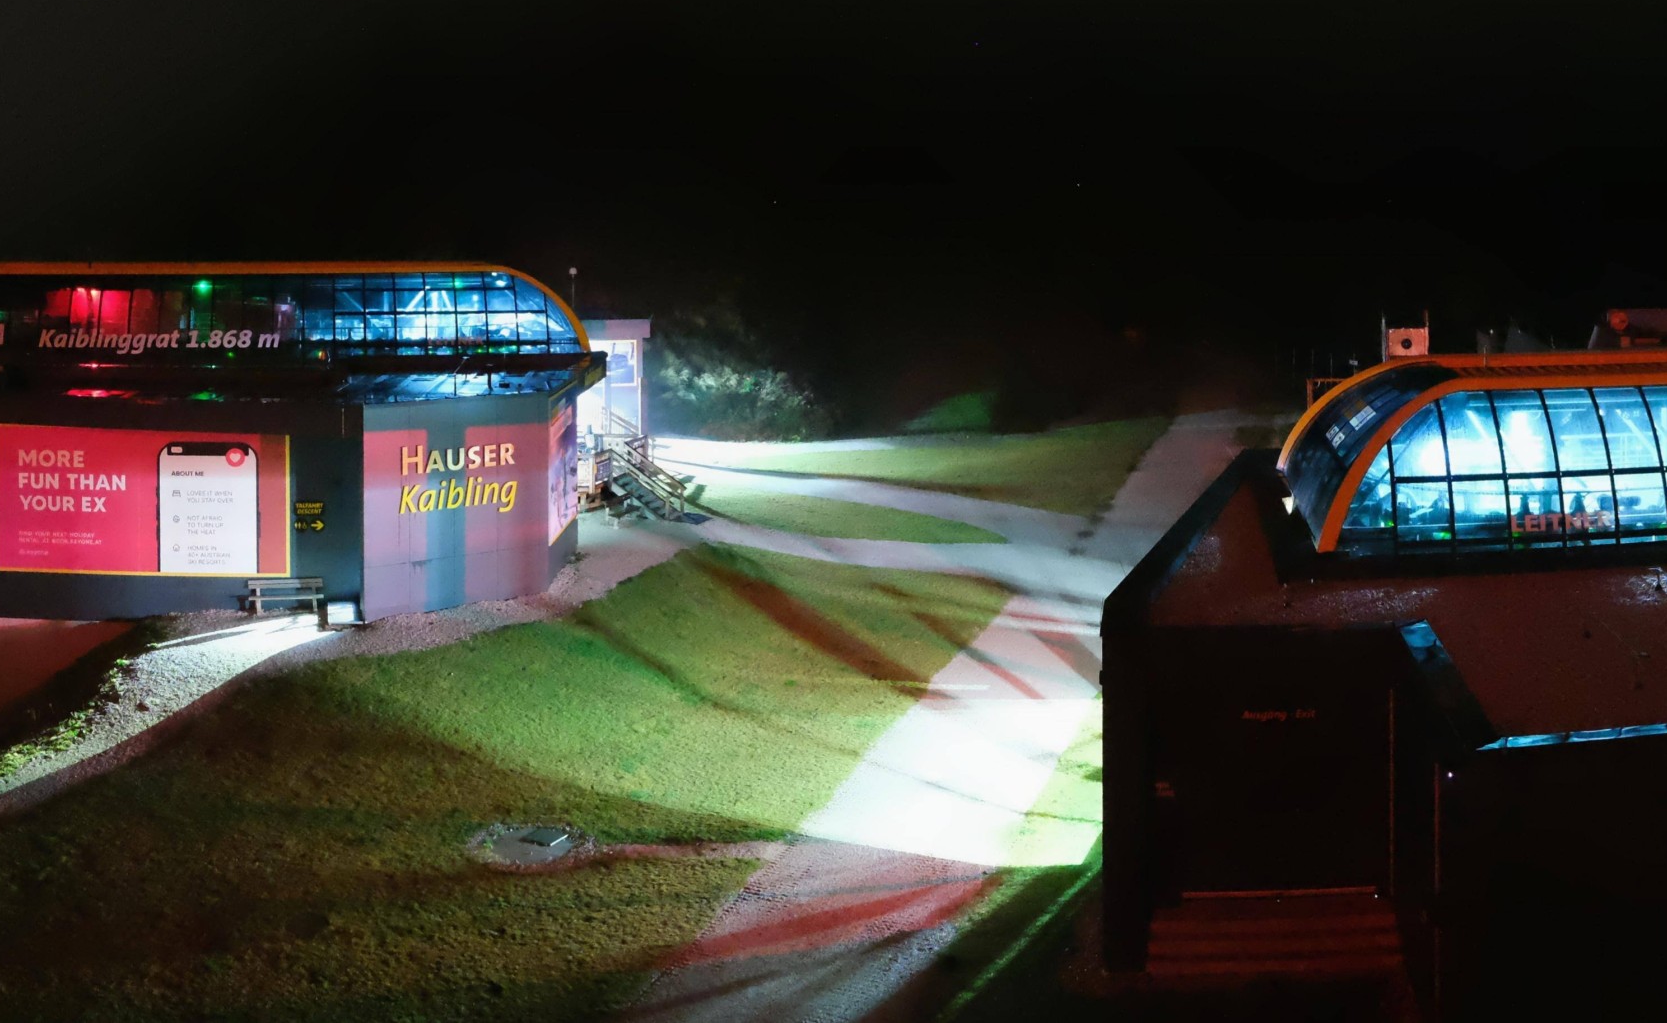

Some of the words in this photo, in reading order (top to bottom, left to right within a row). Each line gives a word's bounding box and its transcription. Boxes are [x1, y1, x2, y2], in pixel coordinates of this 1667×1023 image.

[38, 329, 180, 355] Kaiblinggrat
[185, 329, 252, 348] 1.868
[257, 332, 280, 348] m
[18, 449, 85, 468] MORE
[401, 443, 516, 476] HAUSER
[18, 472, 60, 489] FUN
[66, 473, 127, 491] THAN
[19, 495, 76, 512] YOUR
[81, 496, 108, 513] EX
[399, 476, 518, 515] Kaibling
[1510, 510, 1612, 532] LEITNER
[1241, 709, 1288, 722] Ausgang
[1295, 708, 1317, 719] Exit
